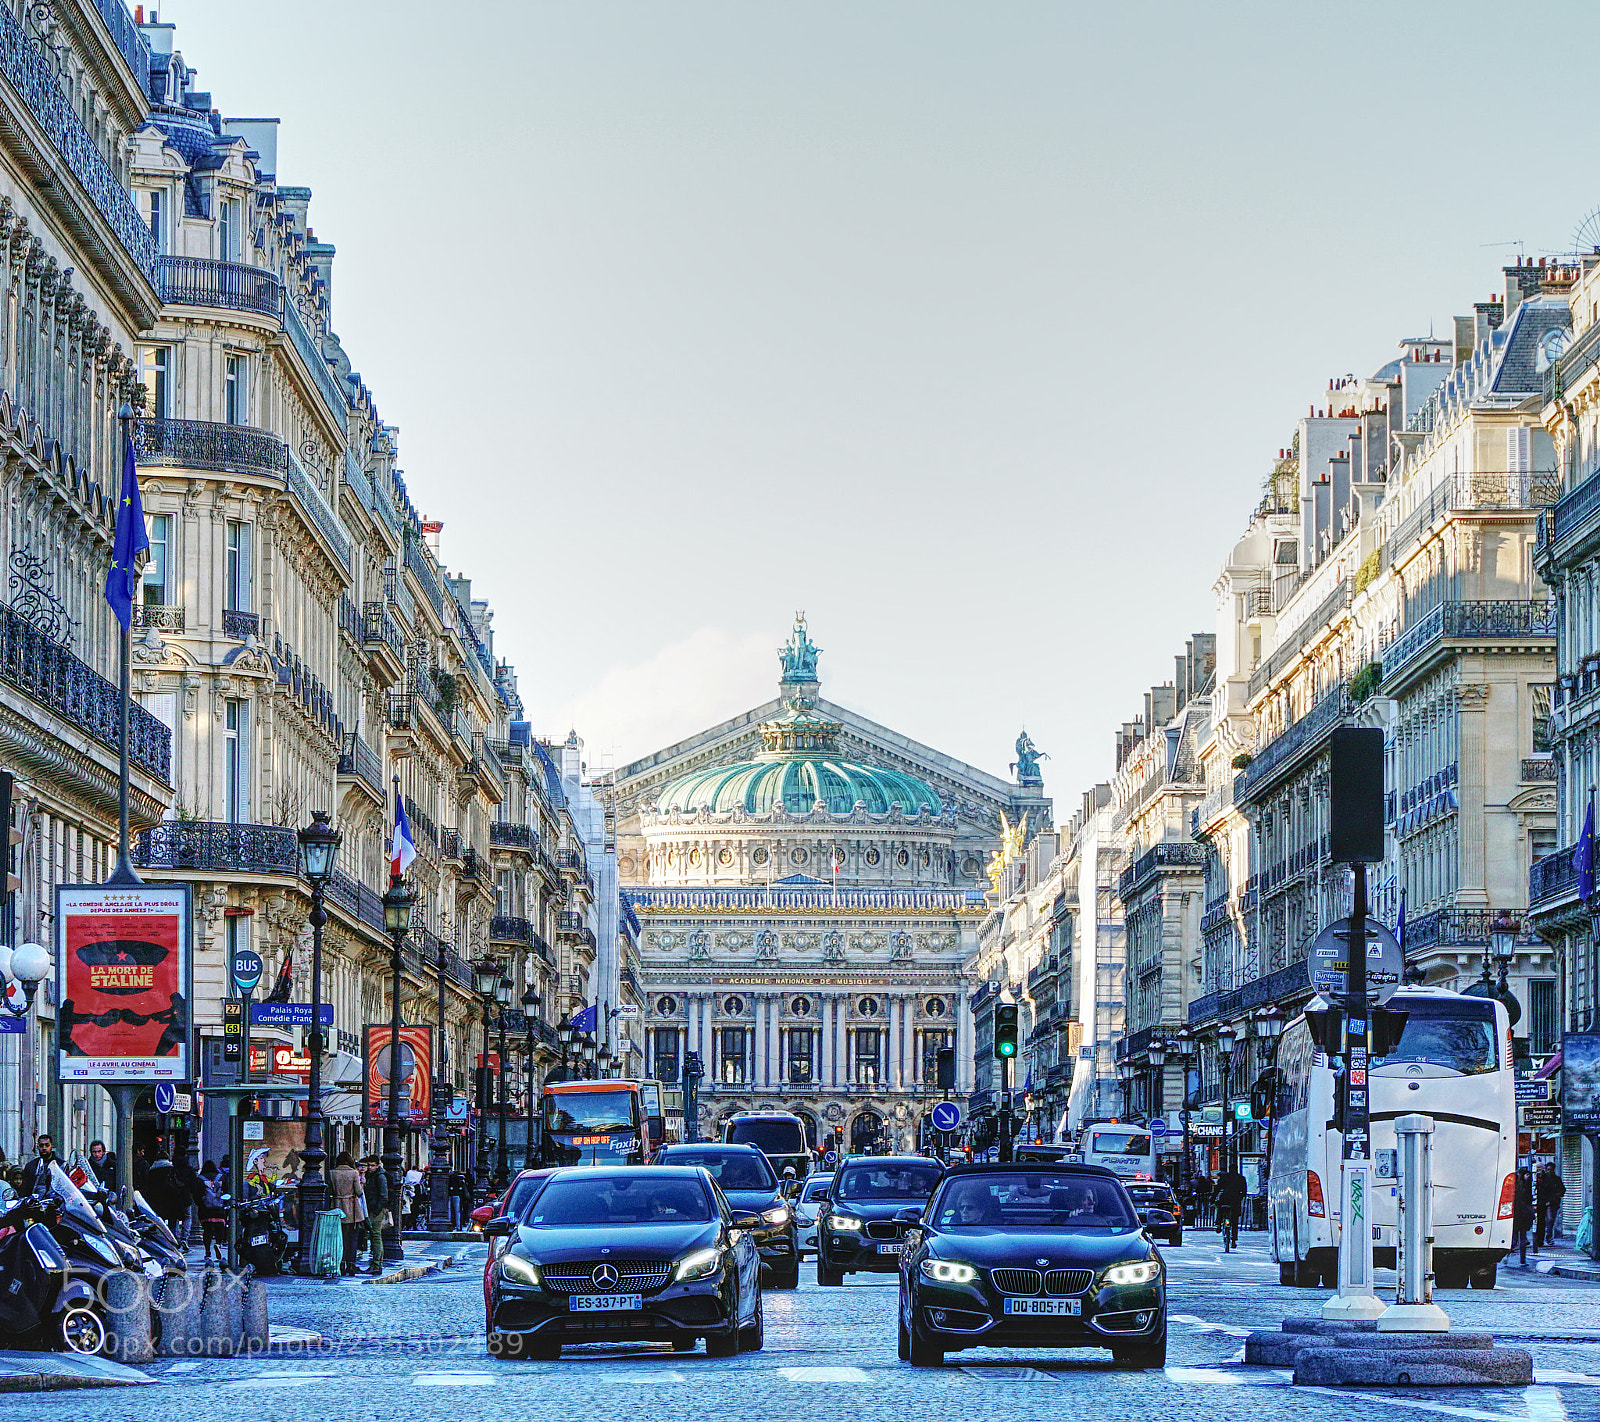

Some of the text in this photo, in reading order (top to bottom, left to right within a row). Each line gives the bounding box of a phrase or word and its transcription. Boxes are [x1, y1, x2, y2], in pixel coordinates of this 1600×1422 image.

[91, 966, 153, 974] LA MORT DE
[236, 960, 258, 971] BUS
[91, 975, 154, 986] STALINE
[295, 1007, 313, 1016] Roya
[293, 1015, 327, 1023] Françse
[226, 1044, 238, 1052] 95
[609, 1137, 641, 1150] Foxity
[577, 1296, 634, 1308] ES-337-PT
[1013, 1300, 1072, 1313] DQ-805-FN
